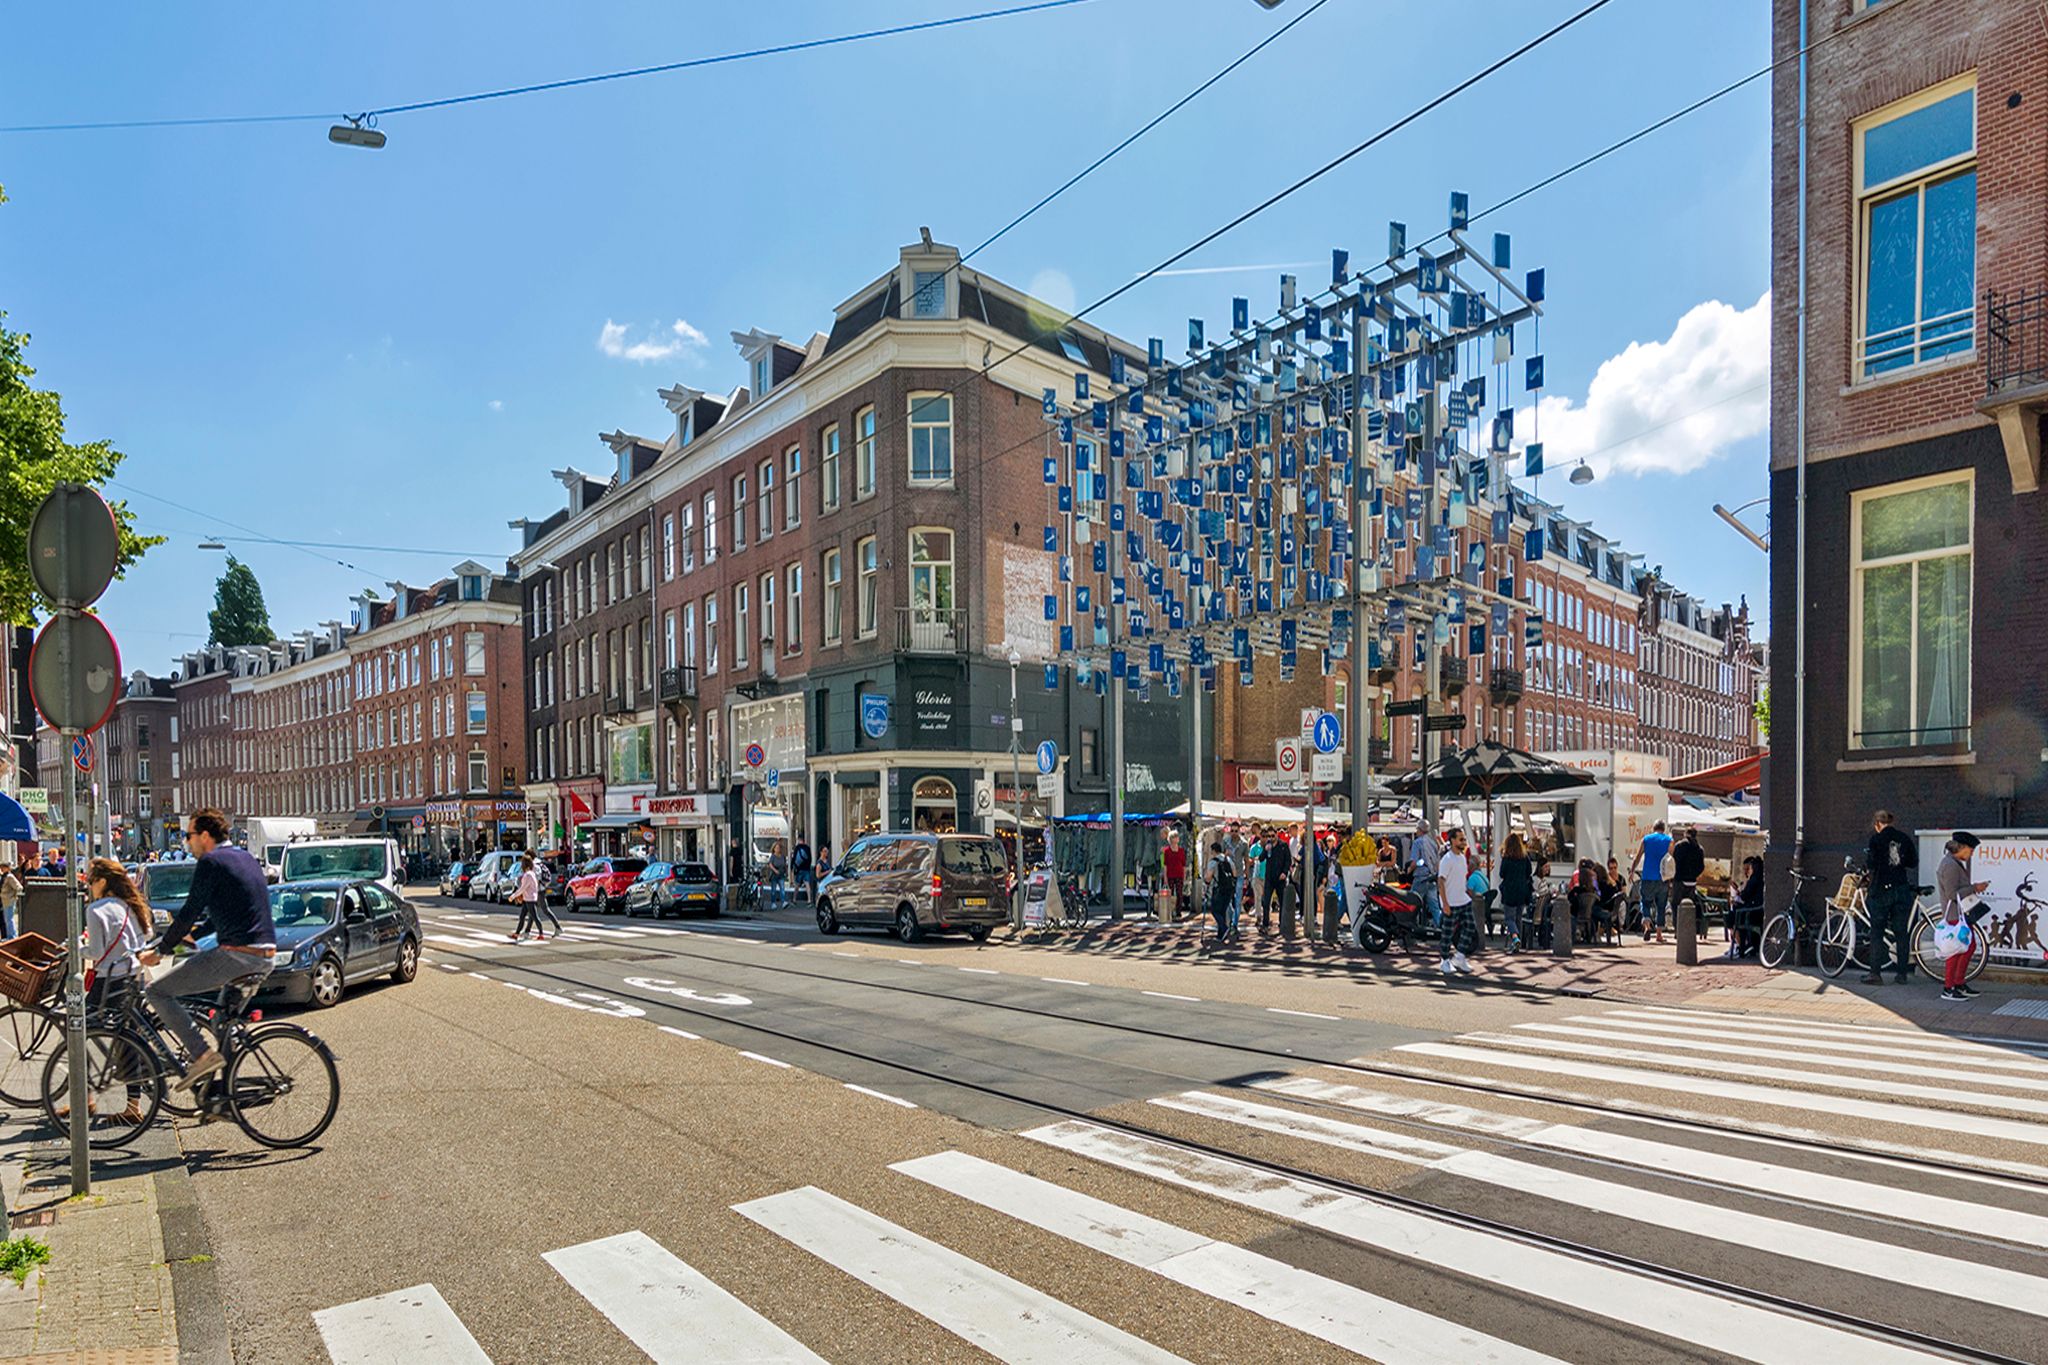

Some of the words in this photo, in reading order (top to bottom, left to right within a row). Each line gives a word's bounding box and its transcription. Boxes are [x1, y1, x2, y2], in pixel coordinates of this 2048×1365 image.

[915, 690, 952, 705] Gloria
[1283, 754, 1293, 765] 30
[1580, 759, 1608, 769] frites
[495, 802, 527, 811] DÖNER
